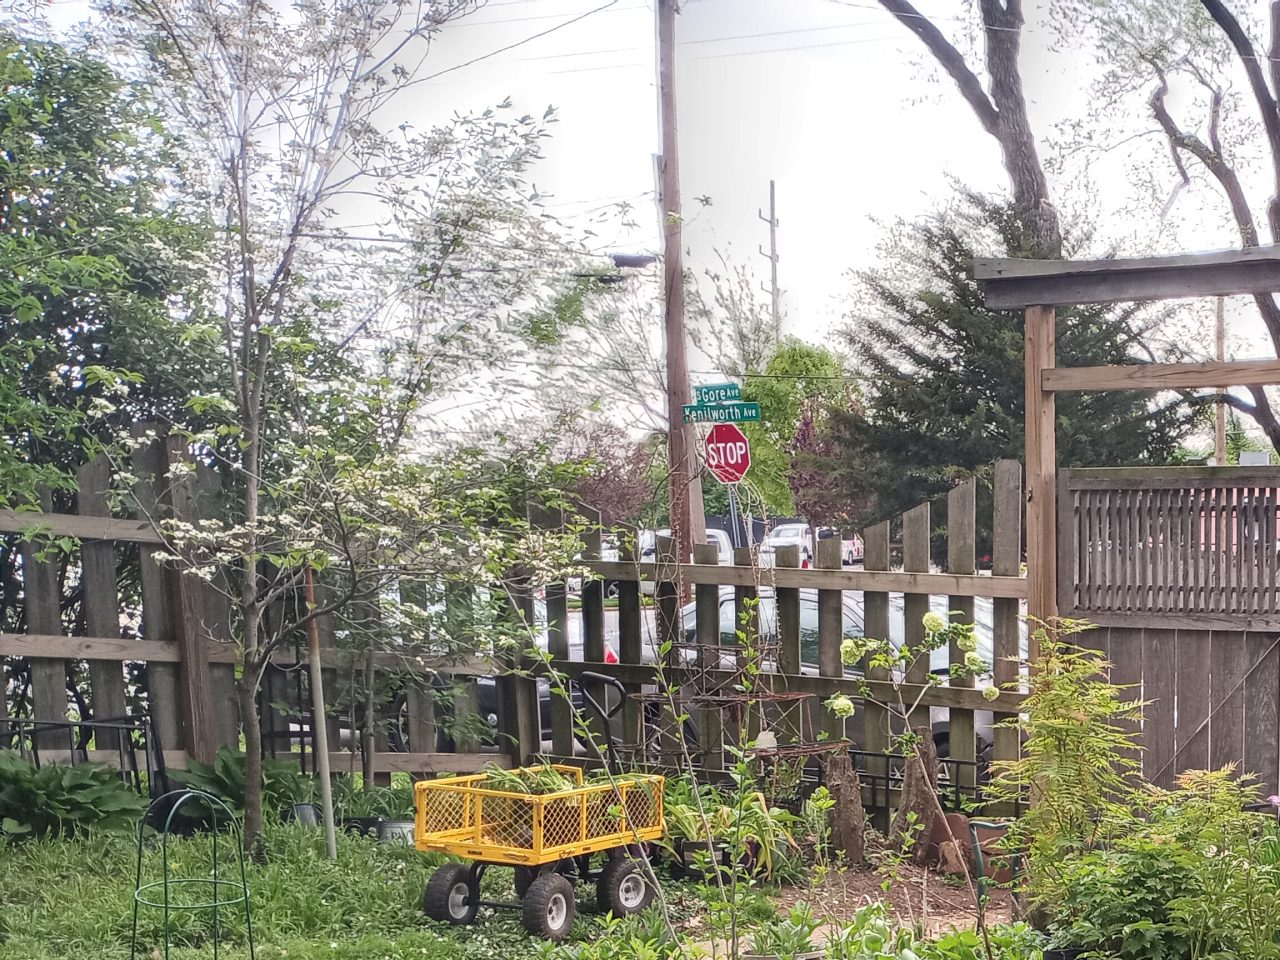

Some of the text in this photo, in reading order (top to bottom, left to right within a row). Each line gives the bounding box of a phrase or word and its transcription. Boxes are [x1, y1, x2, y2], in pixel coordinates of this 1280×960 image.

[702, 388, 726, 402] Gore
[726, 388, 740, 398] Ave
[684, 406, 757, 420] Kenilworth Ave
[708, 442, 746, 466] STOP
